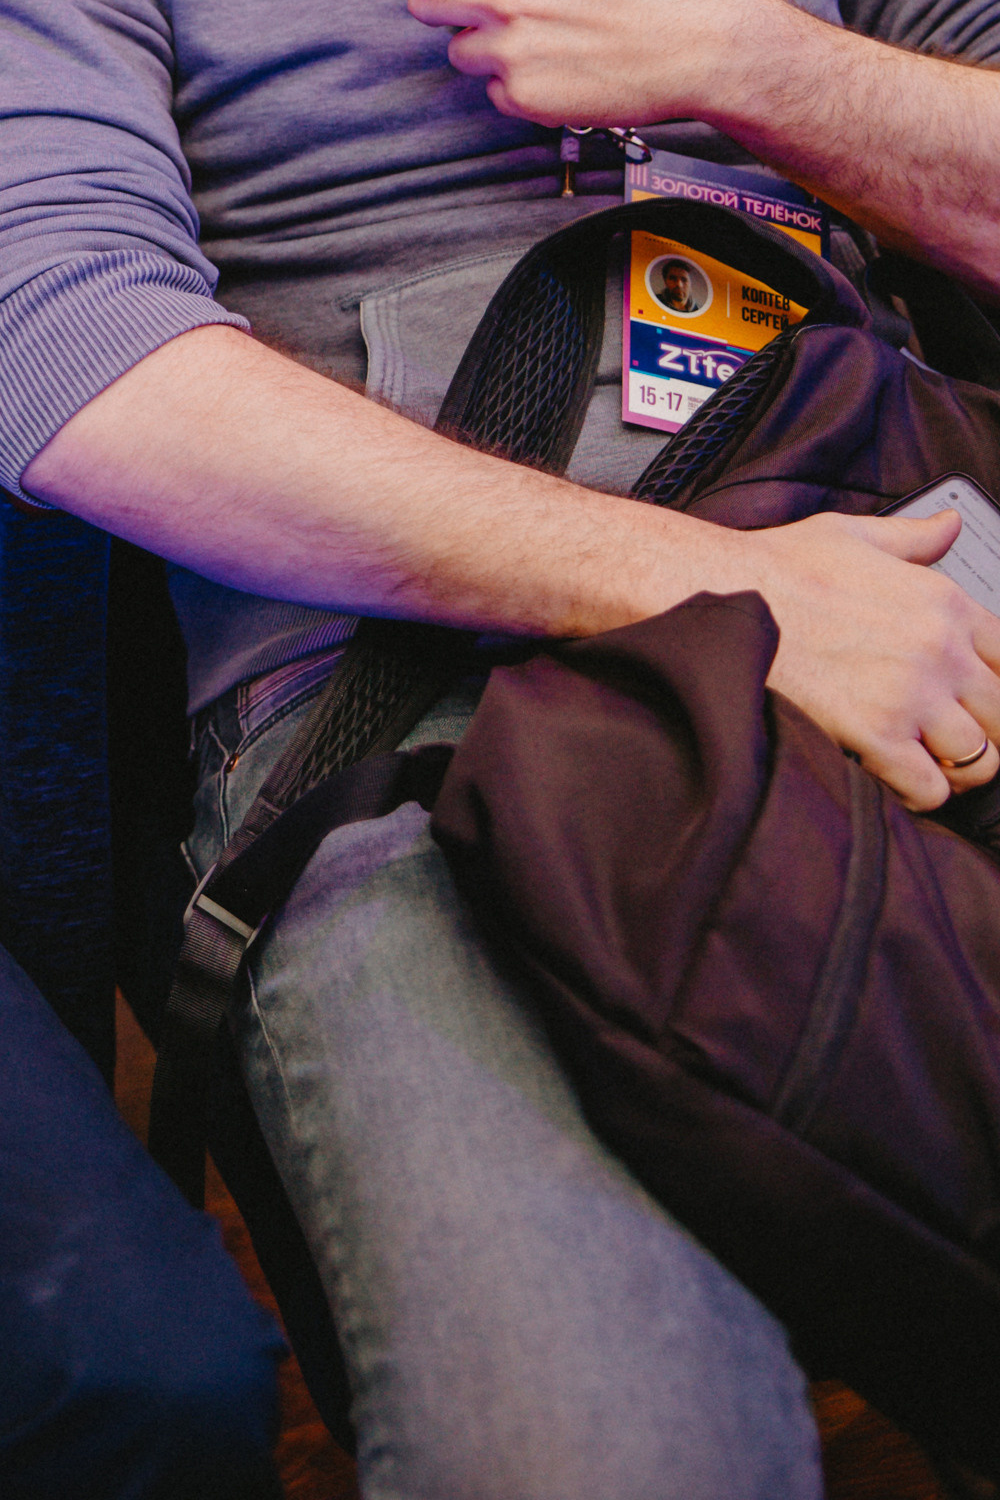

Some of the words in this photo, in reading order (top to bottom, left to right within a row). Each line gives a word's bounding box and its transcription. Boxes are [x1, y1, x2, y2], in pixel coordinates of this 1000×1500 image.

[651, 175, 739, 211] ЗОЛОТОЙ
[742, 197, 822, 232] ТЕЛЁНОК
[742, 285, 791, 312] КОПТЕВ
[742, 306, 789, 331] СЕРГЕЙ
